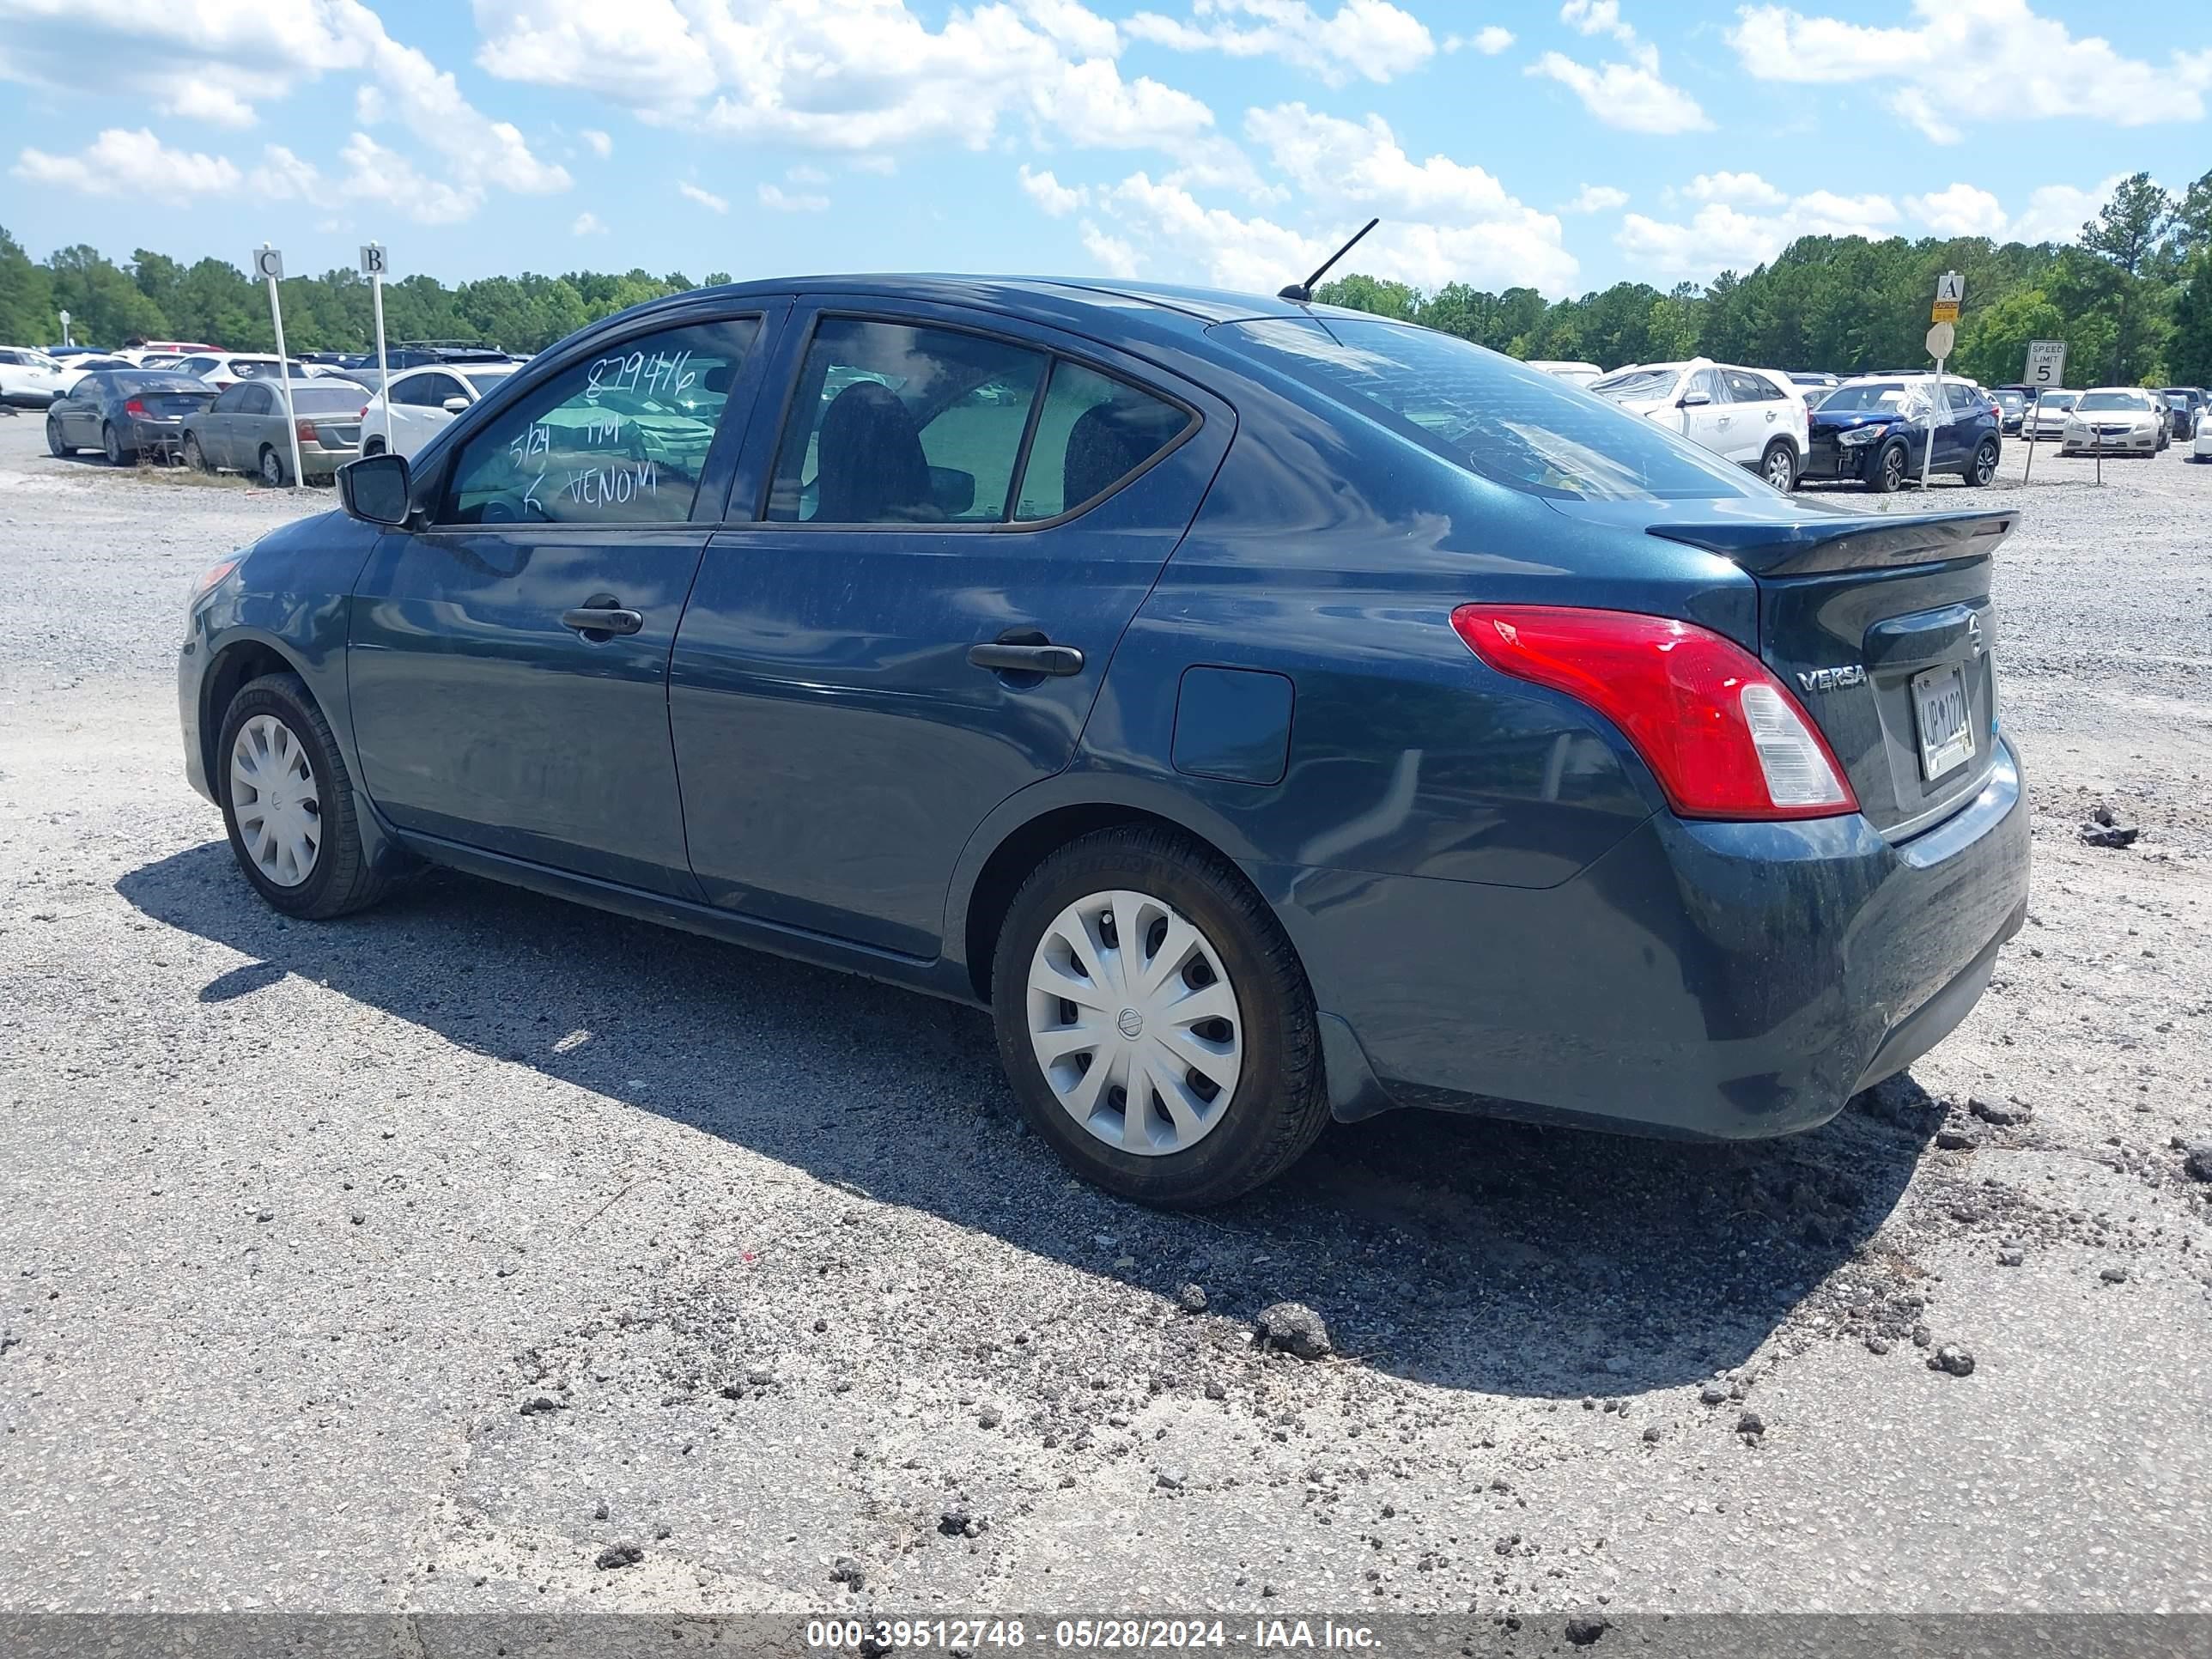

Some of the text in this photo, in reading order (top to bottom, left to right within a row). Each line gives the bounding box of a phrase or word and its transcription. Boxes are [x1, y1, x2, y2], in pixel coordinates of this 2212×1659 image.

[260, 252, 278, 276] C
[367, 249, 381, 271] B
[1942, 279, 1958, 298] A
[2036, 365, 2051, 382] 5
[568, 459, 657, 508] VENOM
[1796, 665, 1868, 690] VERSA
